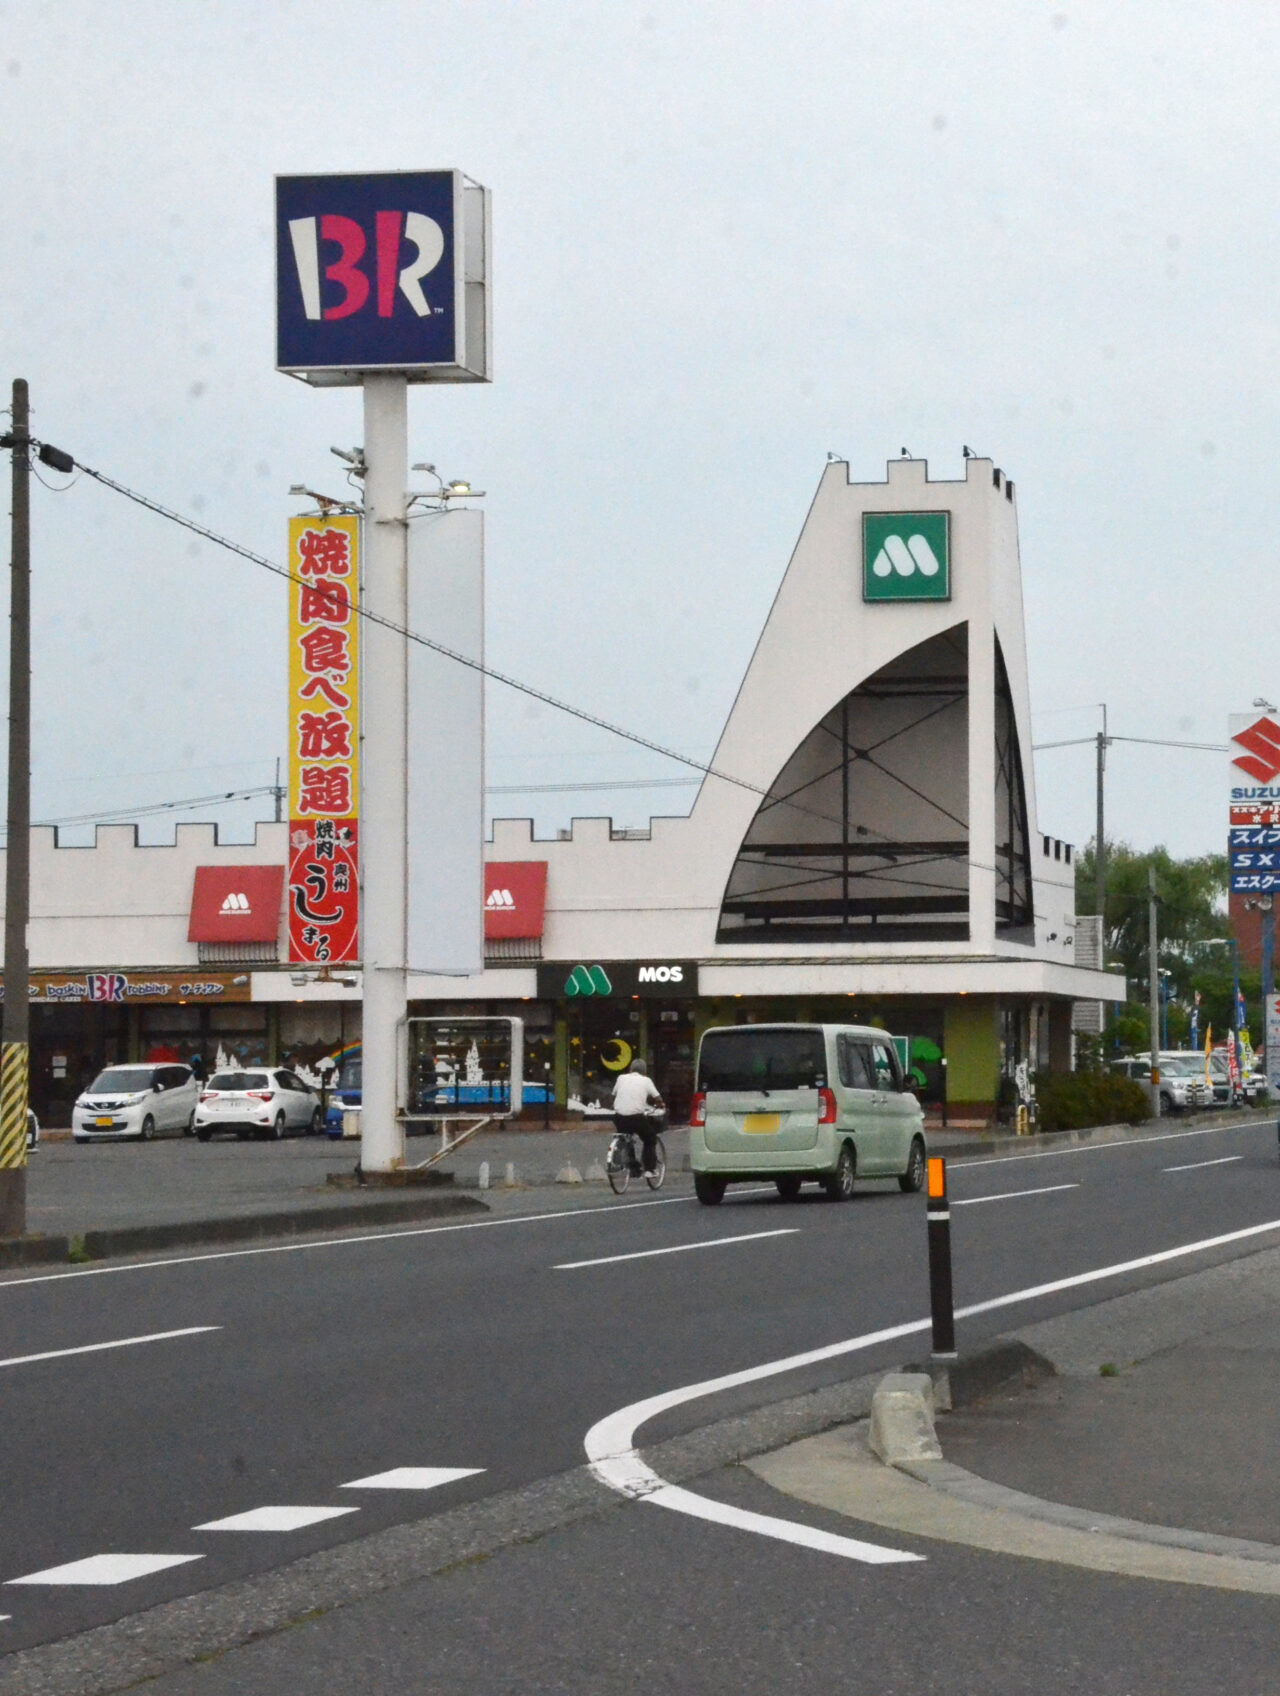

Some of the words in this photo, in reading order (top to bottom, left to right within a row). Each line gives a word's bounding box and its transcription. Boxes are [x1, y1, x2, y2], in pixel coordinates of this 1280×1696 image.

[288, 211, 444, 321] BR
[299, 528, 352, 815] 焼肉食べ放題
[315, 820, 335, 859] 焼肉
[86, 974, 127, 1001] BR
[179, 984, 224, 996] サーティワン
[638, 966, 684, 983] MOS
